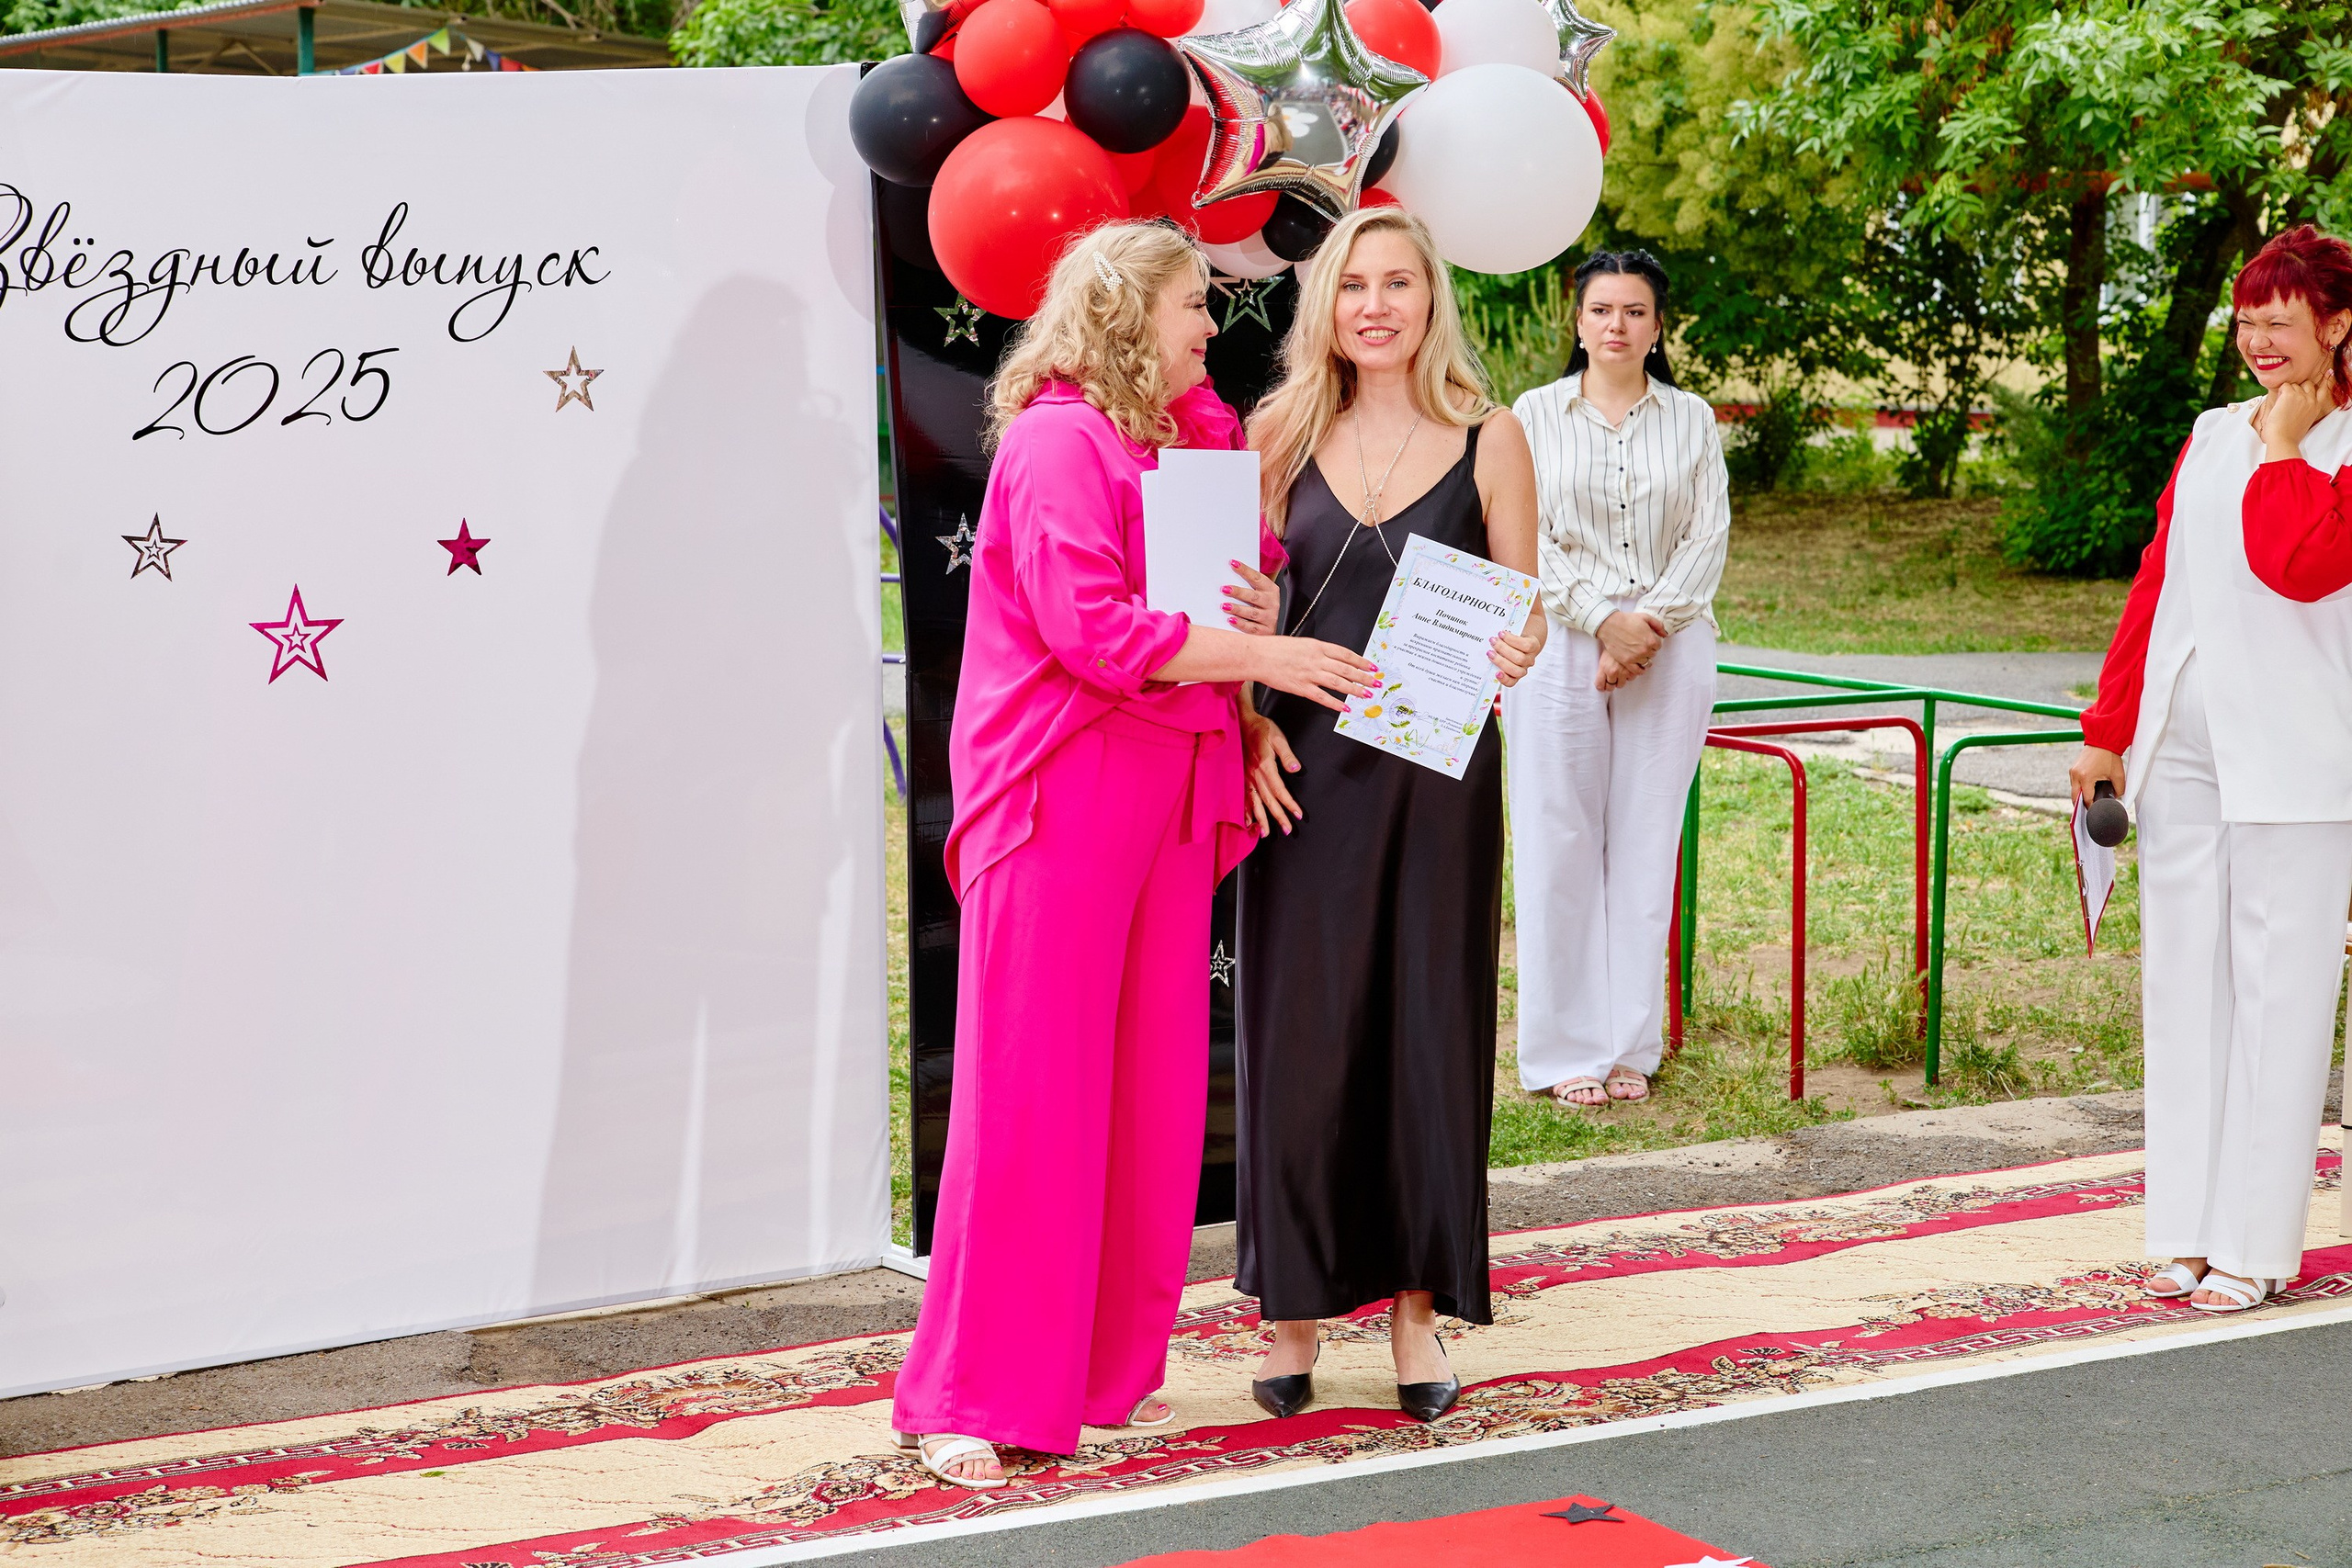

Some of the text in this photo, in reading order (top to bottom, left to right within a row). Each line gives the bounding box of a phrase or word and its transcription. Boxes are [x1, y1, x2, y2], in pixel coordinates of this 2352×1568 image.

[362, 202, 611, 342] выпуск
[131, 347, 400, 441] 2025
[1412, 577, 1506, 617] БЛАГОДАРНОСТЬ
